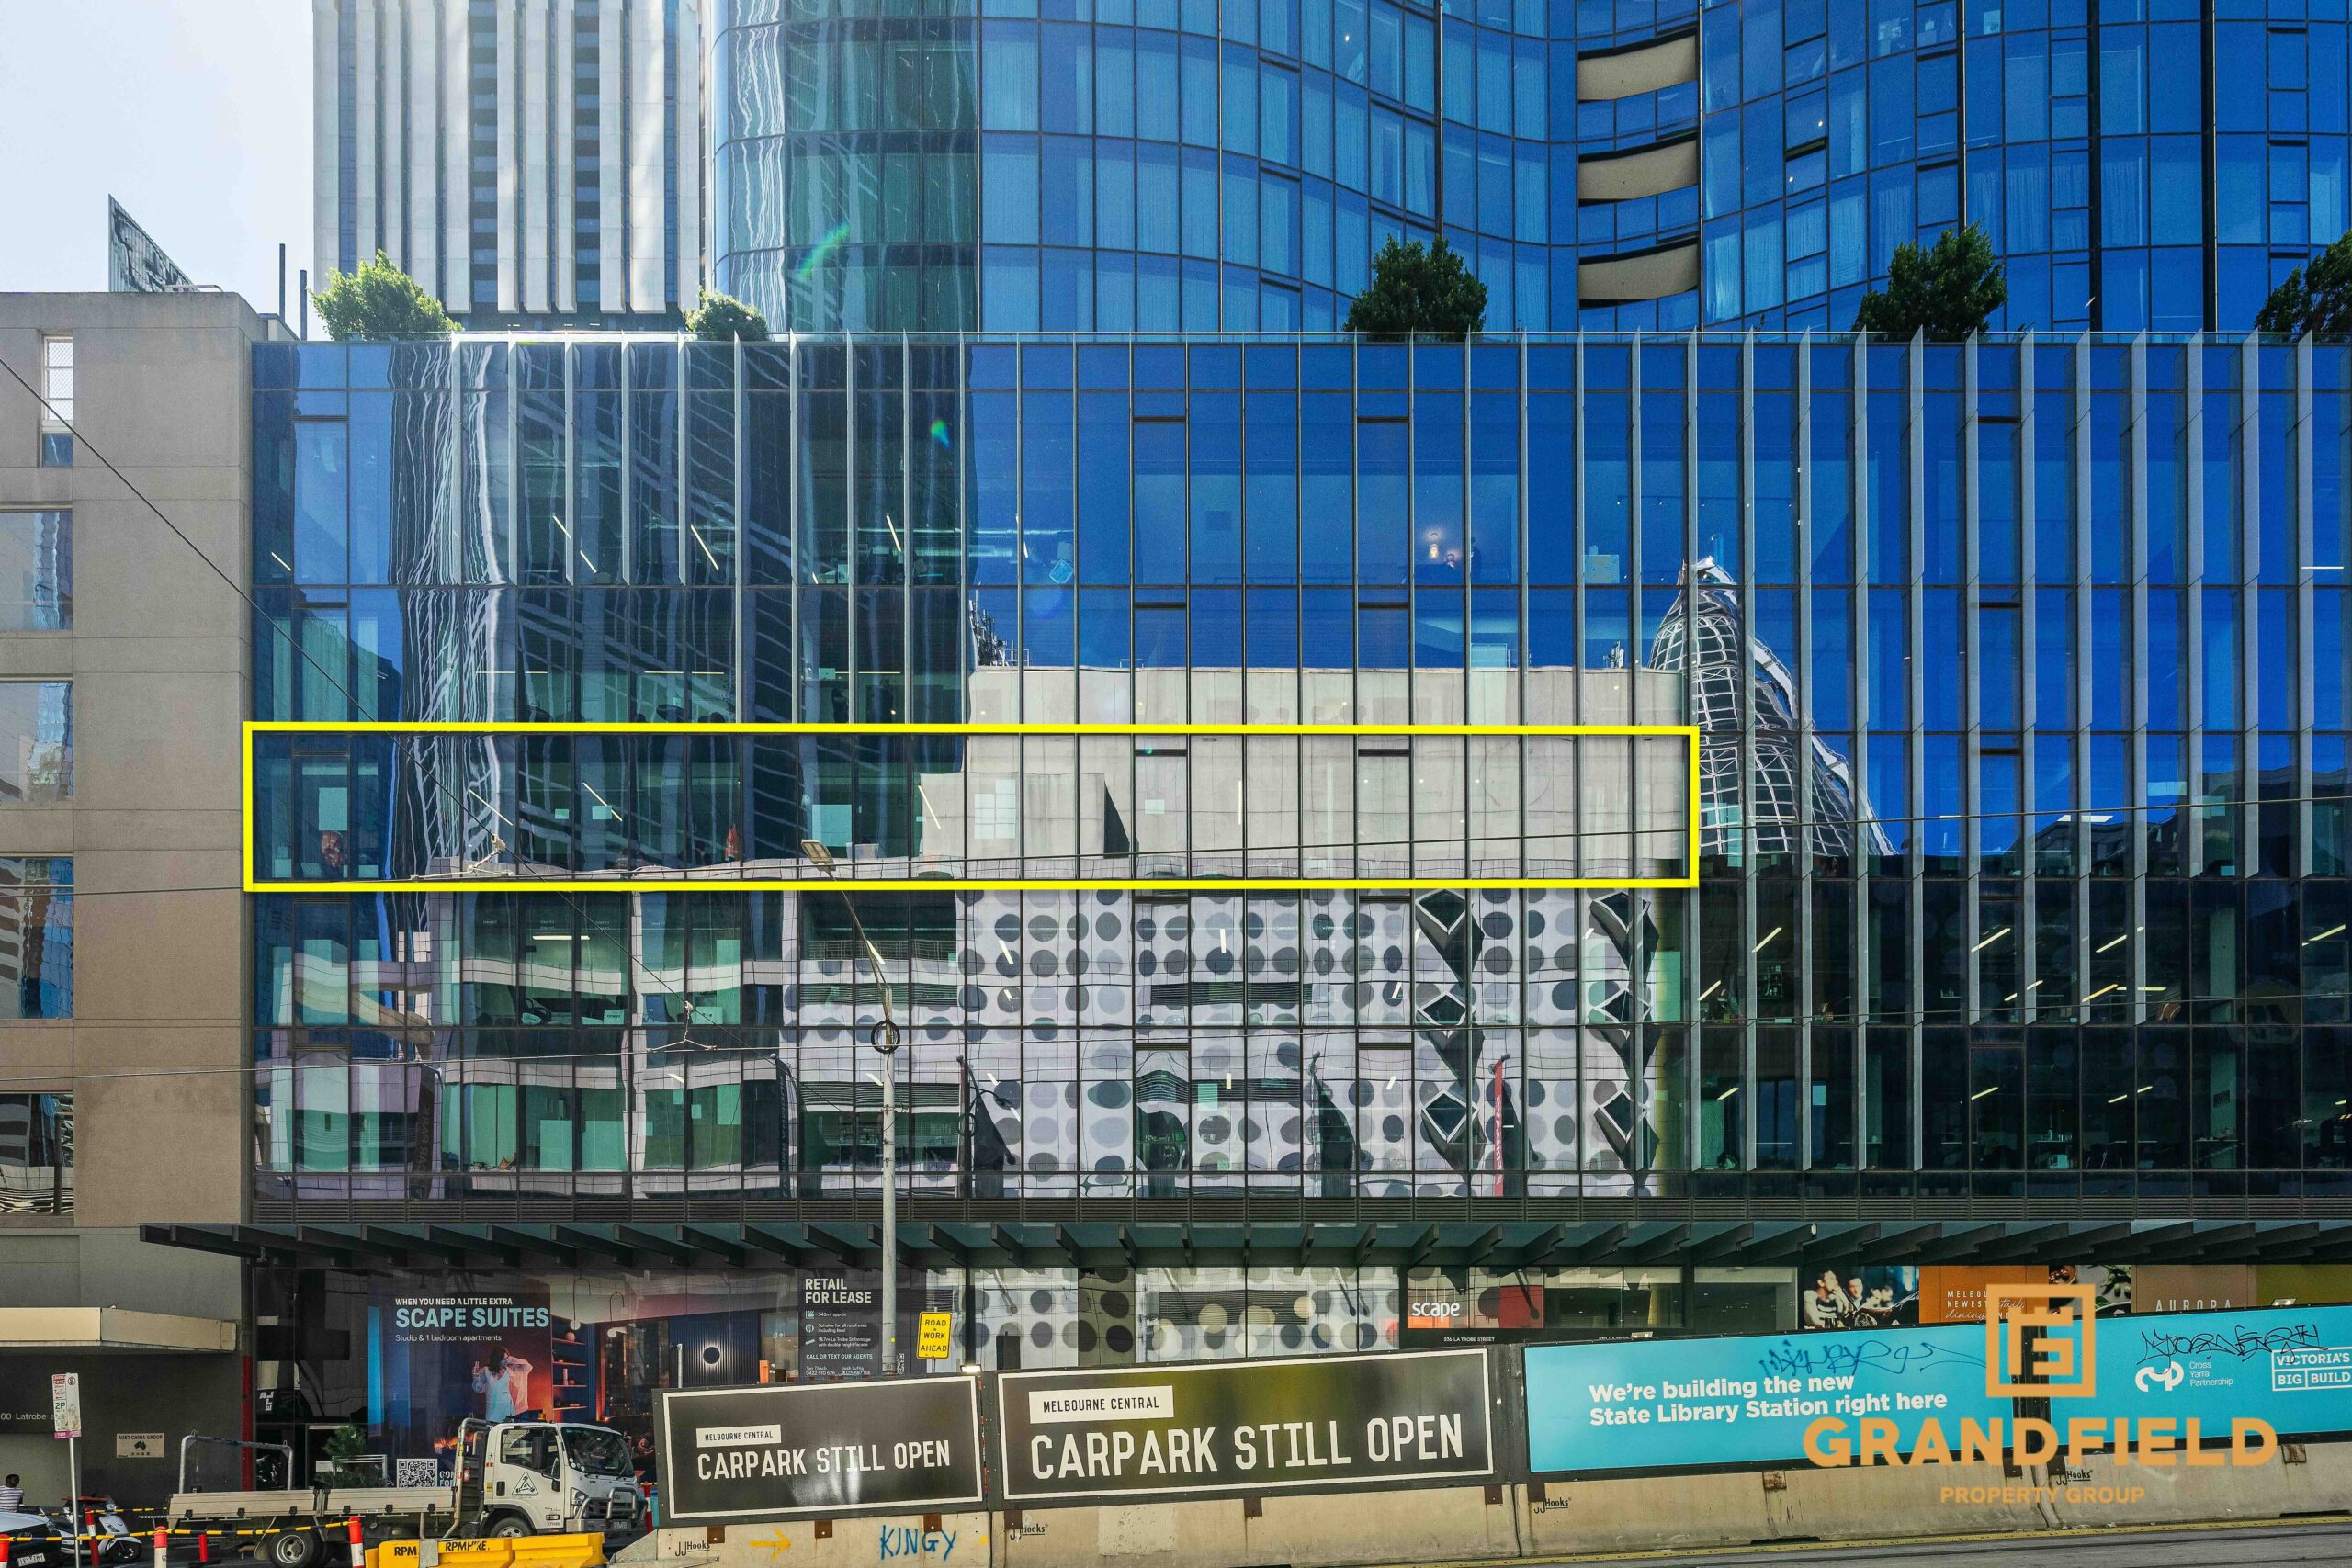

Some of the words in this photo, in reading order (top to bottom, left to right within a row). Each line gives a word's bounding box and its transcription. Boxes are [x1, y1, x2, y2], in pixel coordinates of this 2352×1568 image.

[805, 1279, 848, 1291] RETAIL
[805, 1292, 830, 1303] FOR
[833, 1292, 872, 1303] LEASE
[2155, 1299, 2232, 1312] AURORA
[396, 1307, 467, 1328] SCAPE
[471, 1307, 549, 1328] SUITES
[1411, 1302, 1461, 1323] scape
[920, 1344, 947, 1352] AHEAD
[2189, 1361, 2211, 1370] Cross
[2276, 1352, 2351, 1366] VICTORIA'S
[2189, 1378, 2233, 1387] Partnership
[2278, 1374, 2302, 1385] BIG
[2311, 1371, 2351, 1383] BUILD
[1589, 1383, 1657, 1403] We’re
[1662, 1379, 1758, 1401] building
[1763, 1376, 1804, 1394] the
[1807, 1376, 1855, 1392] new
[55, 1402, 66, 1410] 2P
[1043, 1398, 1105, 1413] MELBOURNE
[1110, 1396, 1160, 1410] CENTRAL
[1589, 1405, 1651, 1427] State
[1657, 1403, 1739, 1424] Library
[1746, 1399, 1829, 1419] Station
[1835, 1393, 1890, 1416] right
[1896, 1391, 1948, 1410] here
[16, 1412, 47, 1420] Latrobe
[704, 1431, 742, 1442] MELBOURNE
[743, 1430, 774, 1440] CENTRAL
[1031, 1427, 1218, 1479] CARPARK
[1233, 1420, 1351, 1470] STILL
[1366, 1413, 1464, 1462] OPEN
[697, 1448, 808, 1480] CARPARK
[816, 1444, 885, 1473] STILL
[893, 1439, 951, 1470] OPEN
[394, 1546, 417, 1557] RPM
